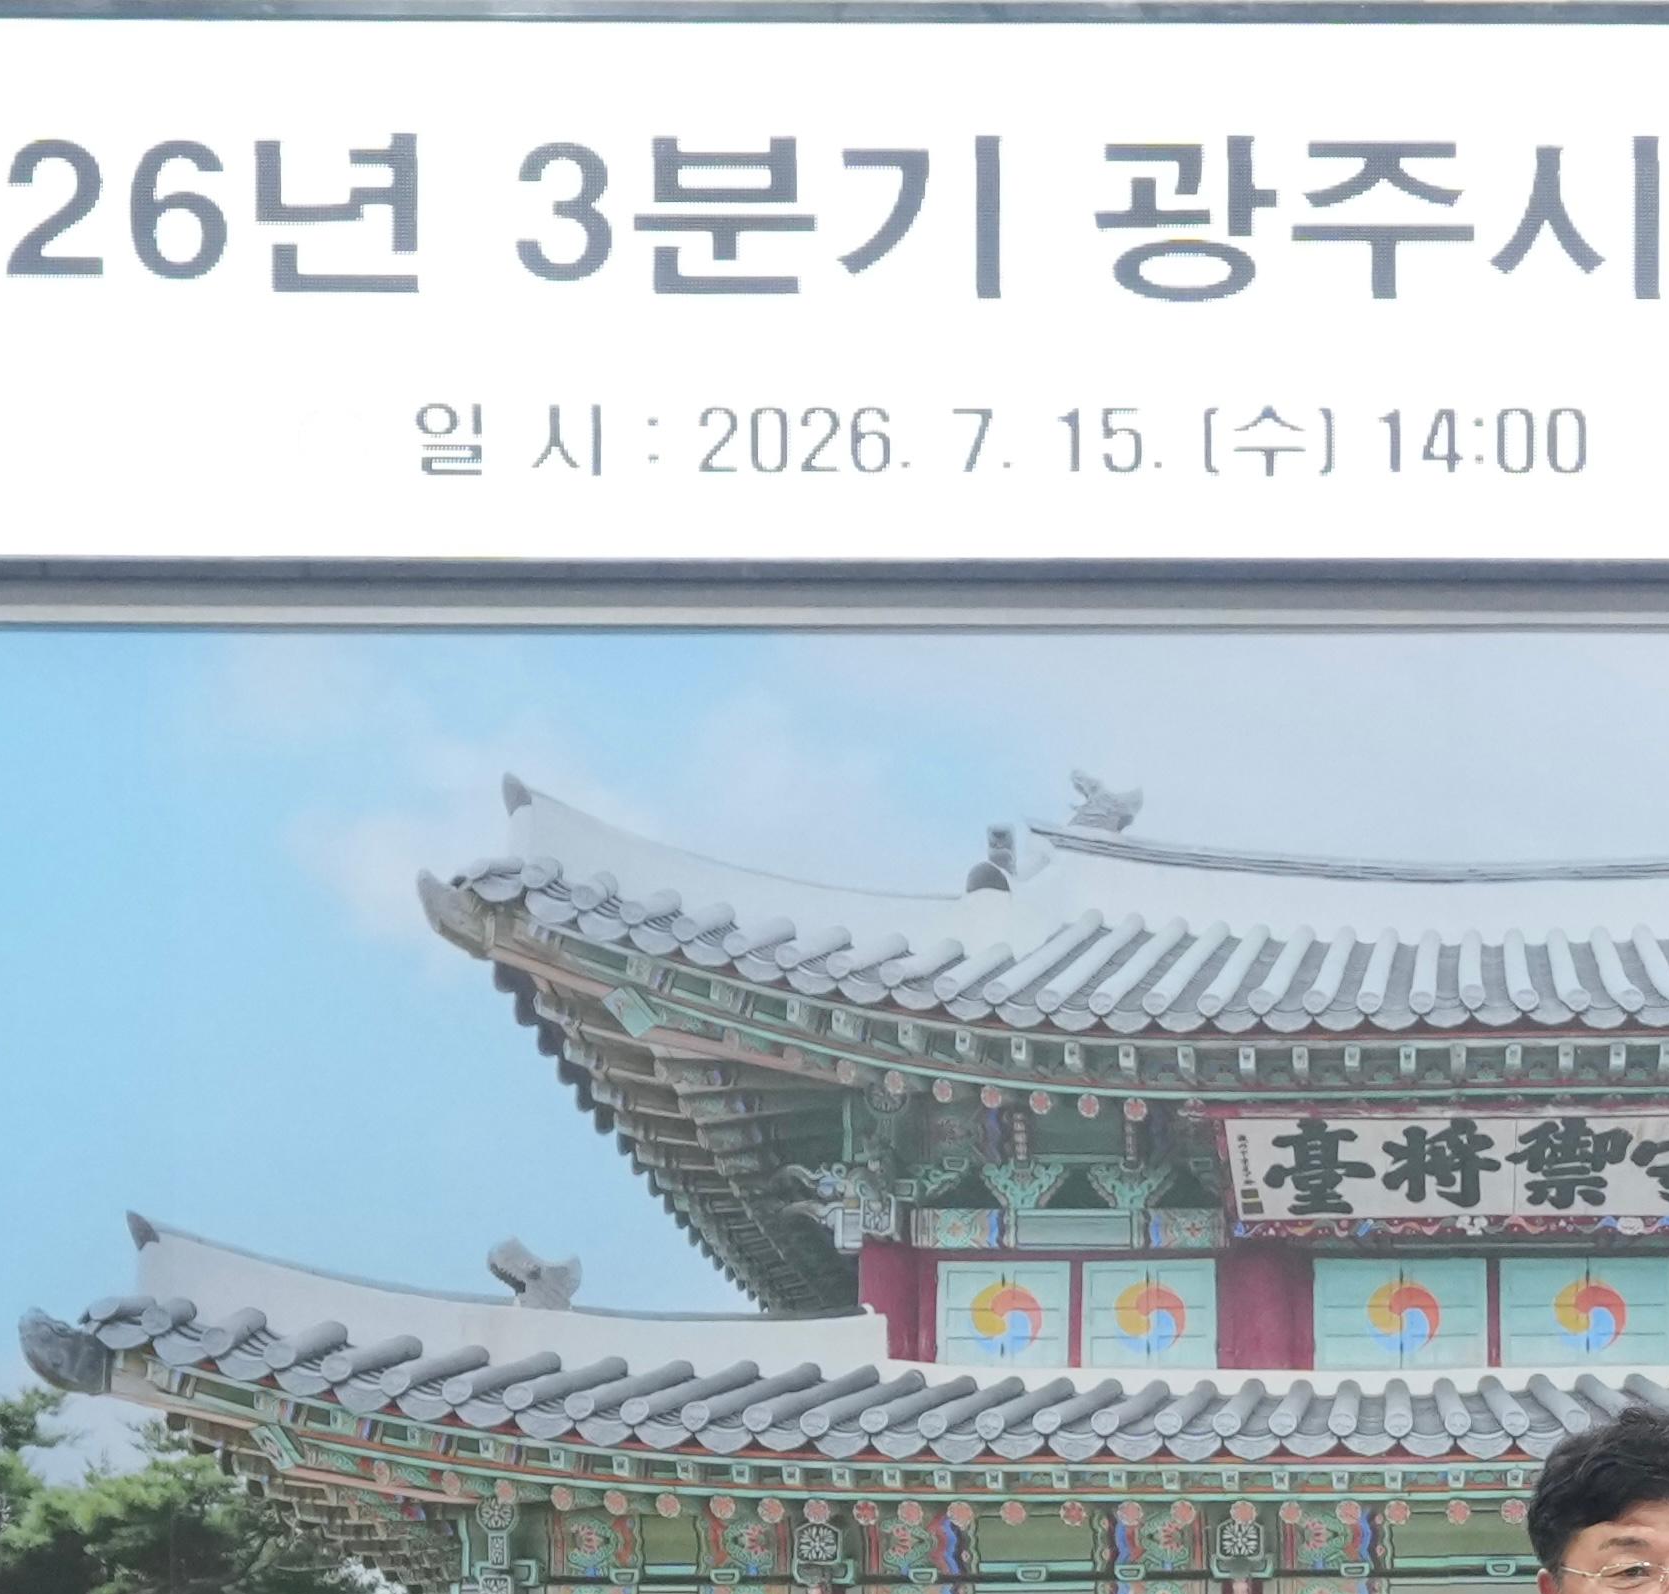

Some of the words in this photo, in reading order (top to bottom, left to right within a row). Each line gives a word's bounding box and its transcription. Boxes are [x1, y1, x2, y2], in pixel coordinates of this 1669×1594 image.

[516, 135, 1002, 300] 3분기
[1093, 134, 1661, 303] 광주시
[698, 407, 911, 475] 2026.
[952, 407, 1011, 474] 7.
[1057, 407, 1163, 474] 15.
[1203, 404, 1336, 477] (수)
[1378, 407, 1588, 475] 14:00
